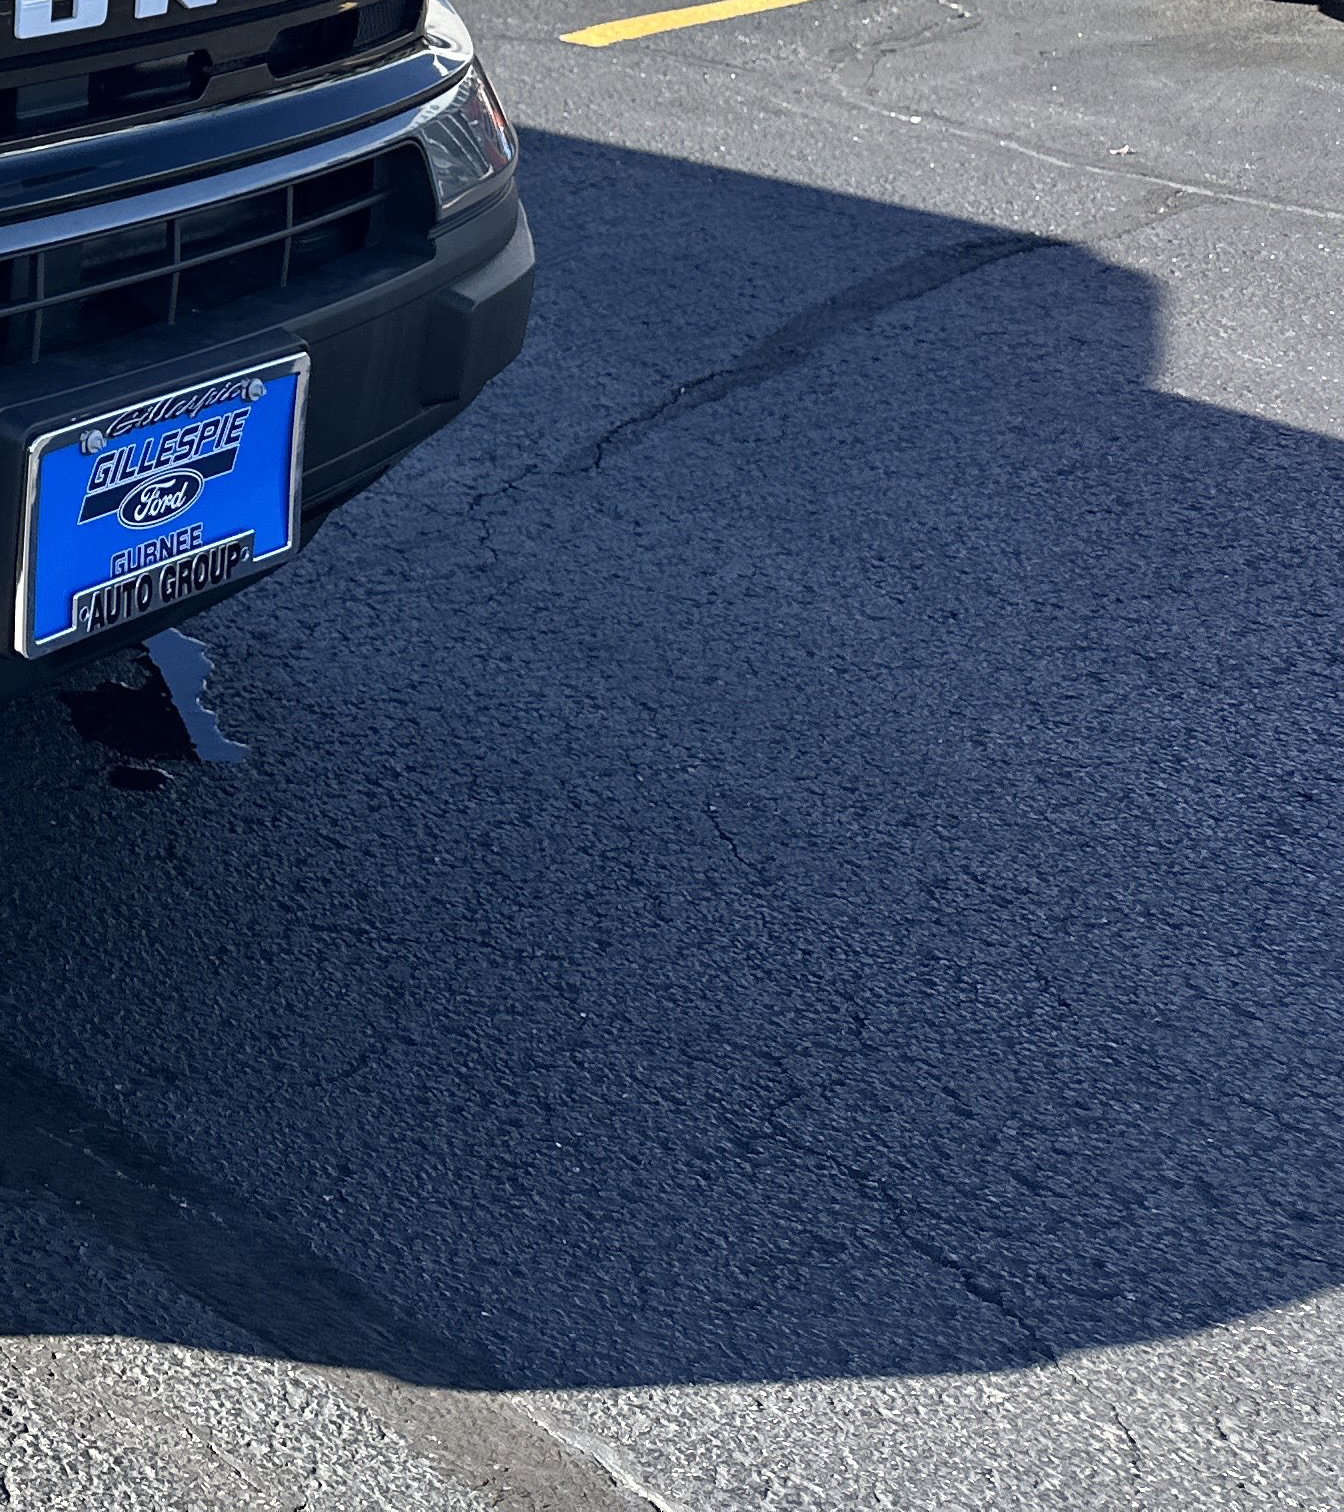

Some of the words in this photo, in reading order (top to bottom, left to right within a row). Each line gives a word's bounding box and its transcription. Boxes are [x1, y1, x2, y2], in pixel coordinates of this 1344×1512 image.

[87, 406, 251, 494] GILLESPIE
[134, 479, 187, 522] Ford
[110, 522, 203, 578] GURNEE
[87, 571, 154, 633] AUTO
[159, 542, 241, 604] GROUP
